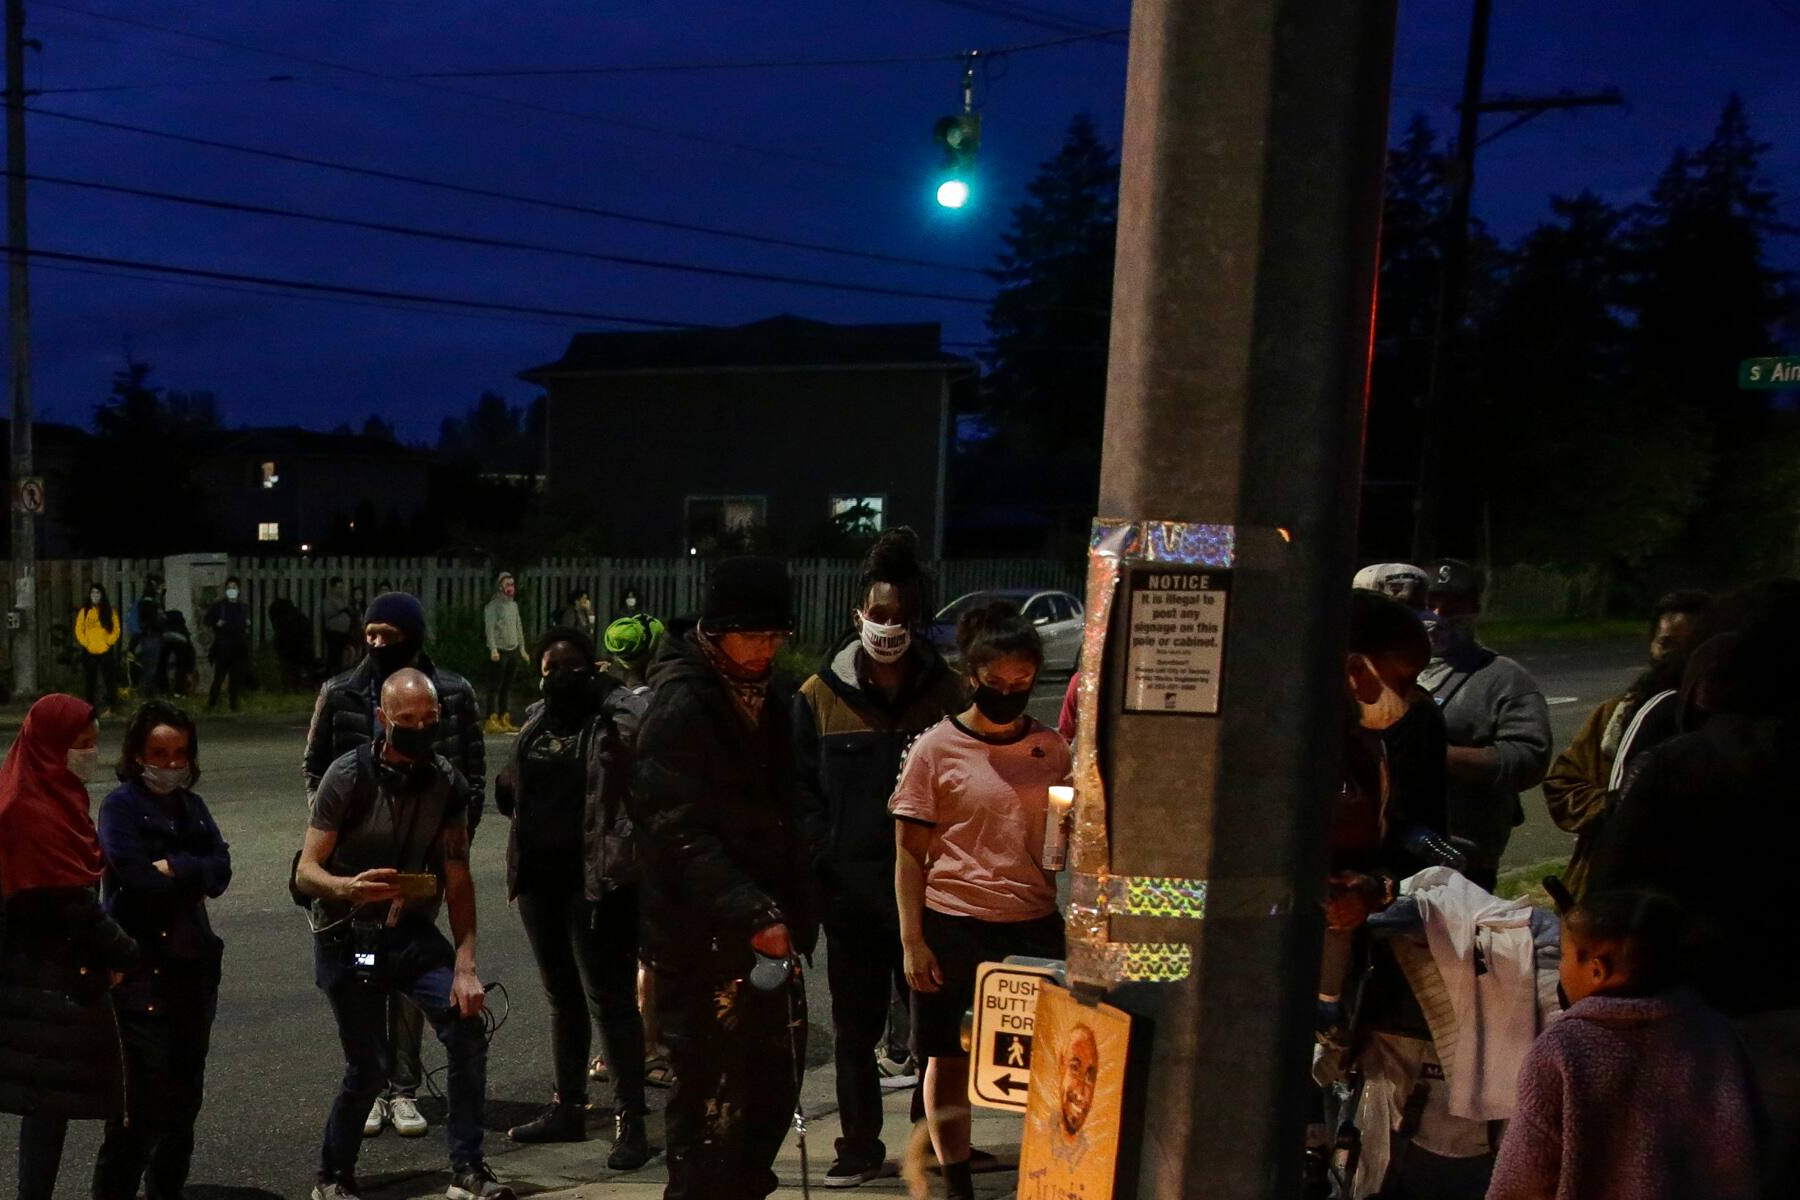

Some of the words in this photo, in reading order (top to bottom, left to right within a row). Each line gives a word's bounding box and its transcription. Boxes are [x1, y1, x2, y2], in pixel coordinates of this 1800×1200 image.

[1148, 575, 1210, 590] NOTICE
[1166, 594, 1199, 607] illegal
[1203, 595, 1215, 605] to
[1153, 608, 1177, 620] post
[1180, 609, 1200, 620] any
[1135, 623, 1177, 635] signage
[1180, 624, 1194, 633] on
[1198, 622, 1218, 633] this
[1158, 638, 1169, 646] or
[998, 979, 1040, 996] PUSH
[1001, 1014, 1034, 1031] FOR
